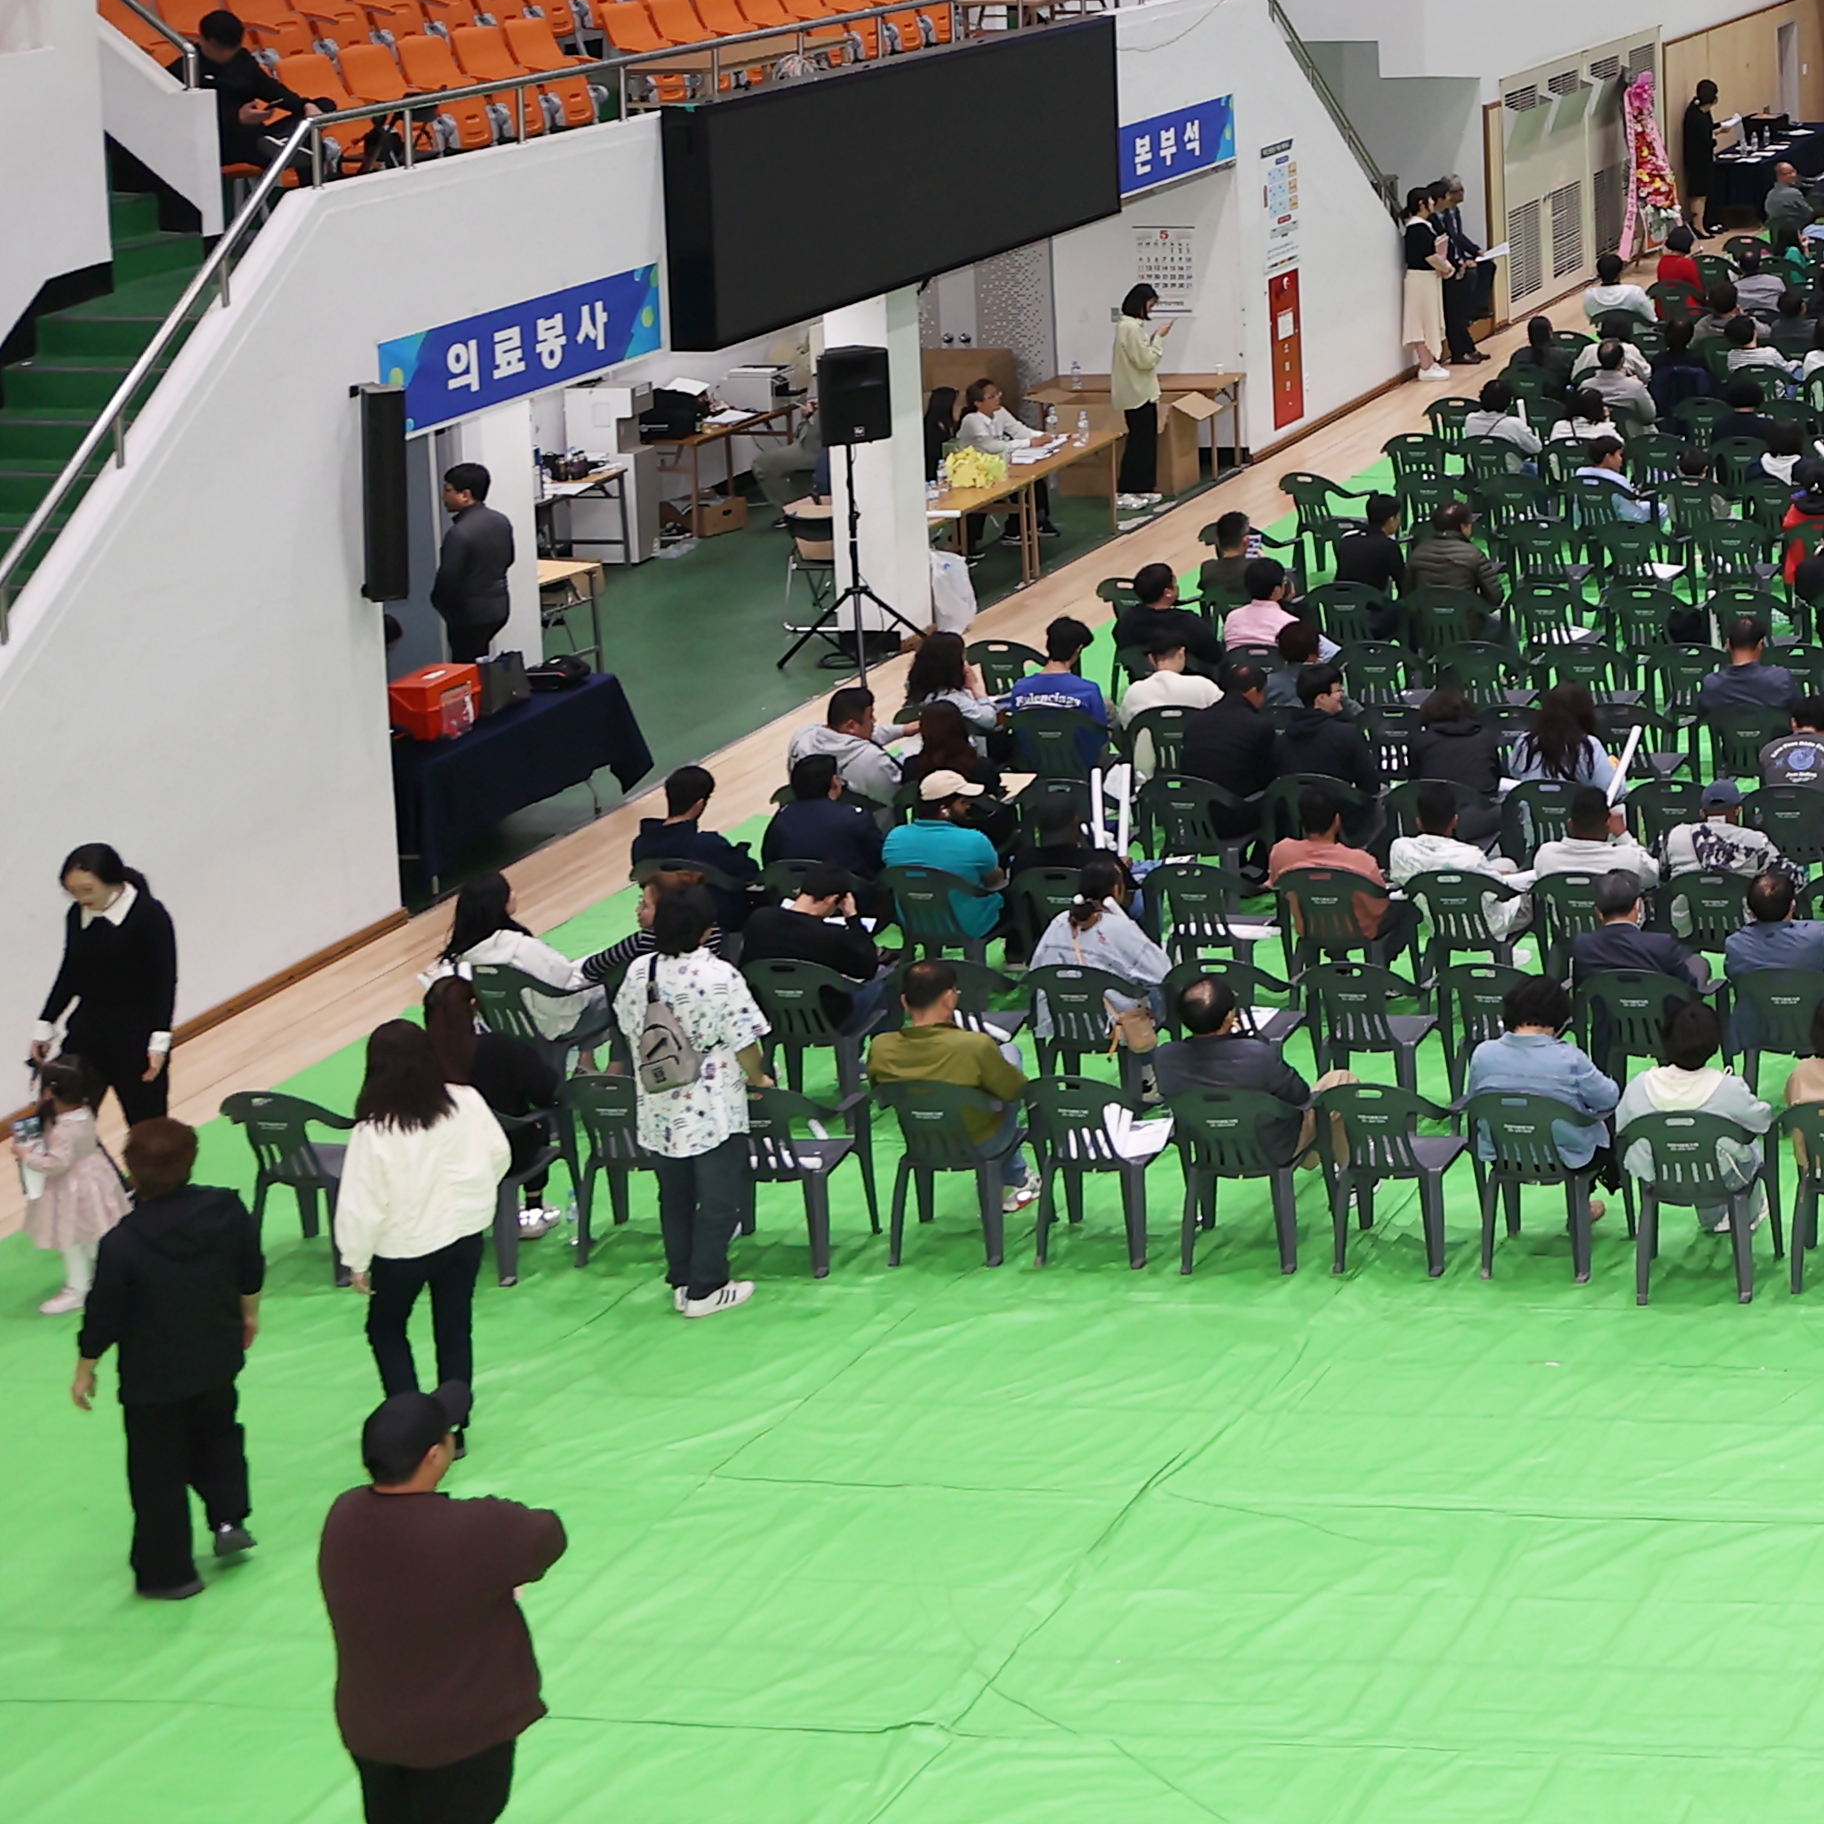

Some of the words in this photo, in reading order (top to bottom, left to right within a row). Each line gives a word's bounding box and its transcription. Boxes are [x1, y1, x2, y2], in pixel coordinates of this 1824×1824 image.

[1134, 119, 1203, 176] 본부석
[1160, 229, 1170, 240] 5
[446, 299, 608, 393] 의료봉사
